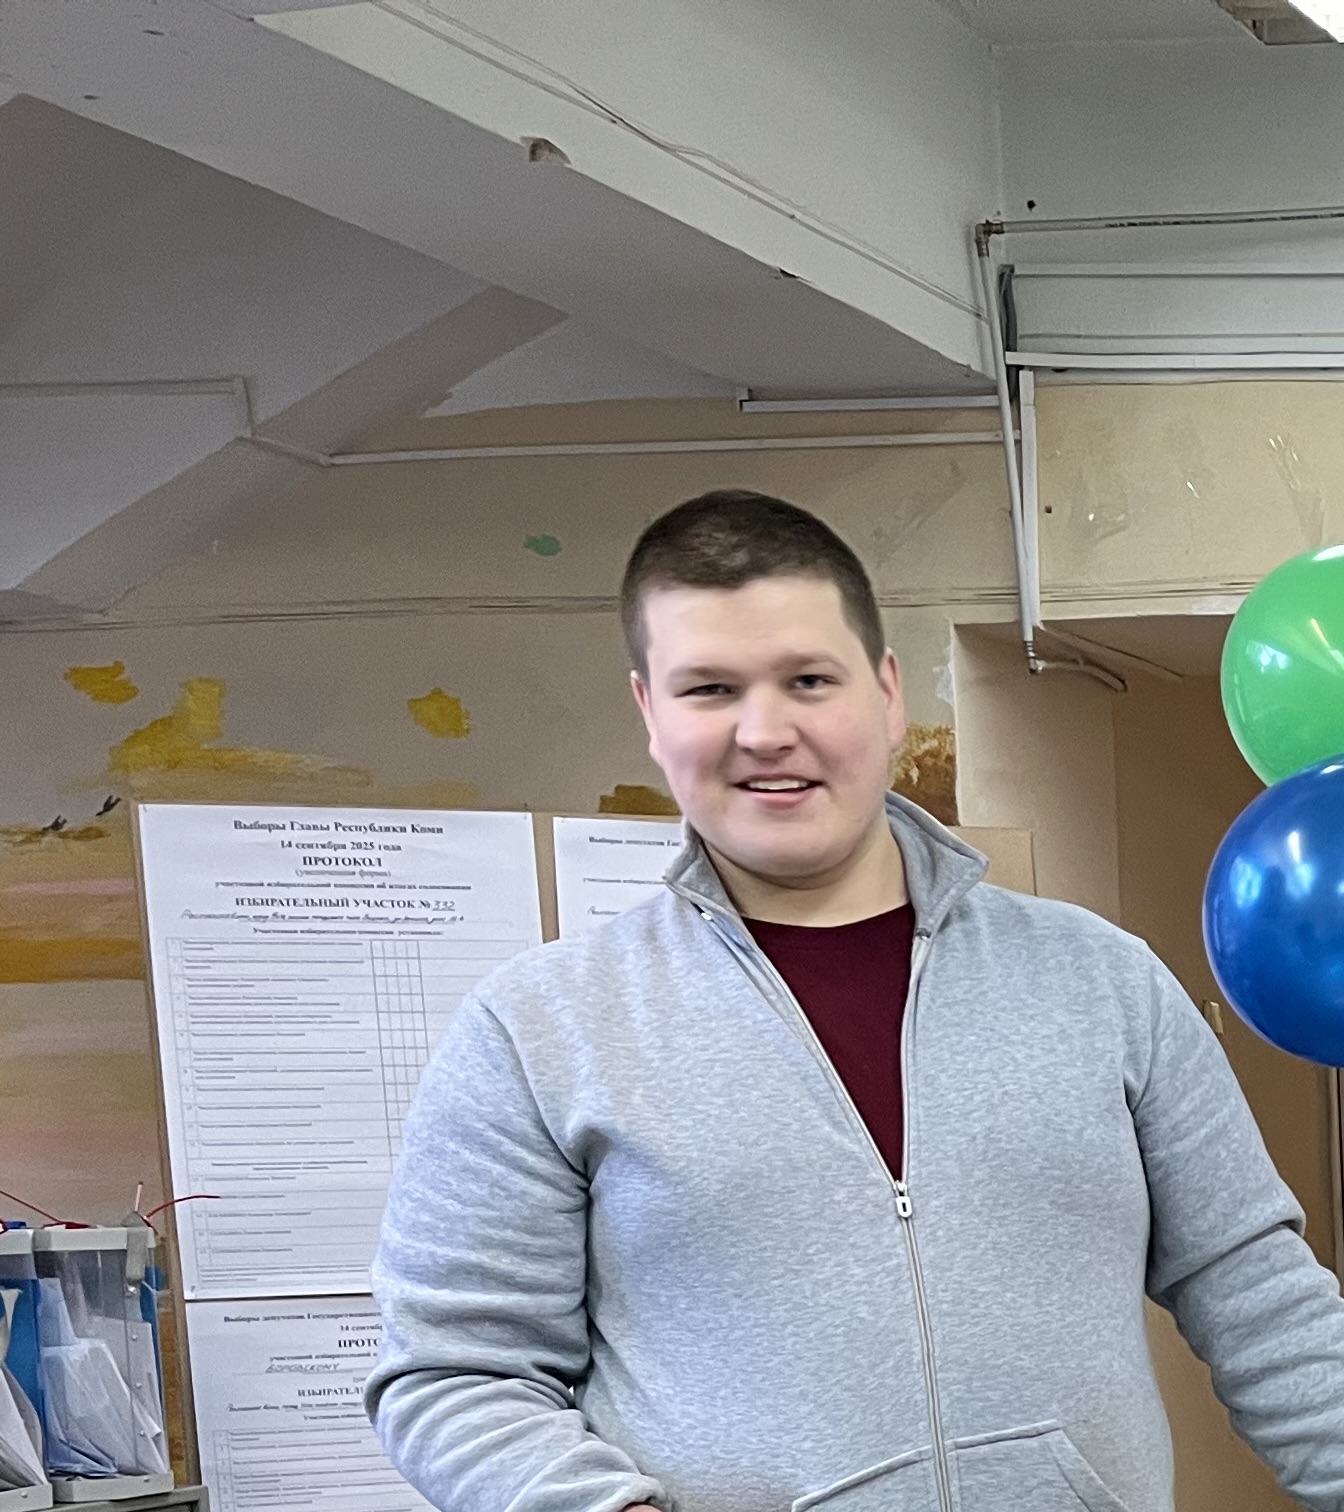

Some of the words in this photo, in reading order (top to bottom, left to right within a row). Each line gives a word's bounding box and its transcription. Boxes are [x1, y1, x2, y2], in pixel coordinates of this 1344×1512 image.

[234, 820, 286, 833] Выборы
[290, 821, 330, 832] Главы
[334, 822, 407, 835] Республики
[411, 824, 443, 834] Коми
[295, 841, 347, 851] сентября
[350, 842, 375, 850] 2025
[302, 856, 382, 867] ПРОТОКОЛ
[235, 897, 350, 908] ИЗБИРАТЕЛЬНЫЙ
[354, 899, 415, 909] УЧАСТОК
[338, 1337, 379, 1348] ПРОТО
